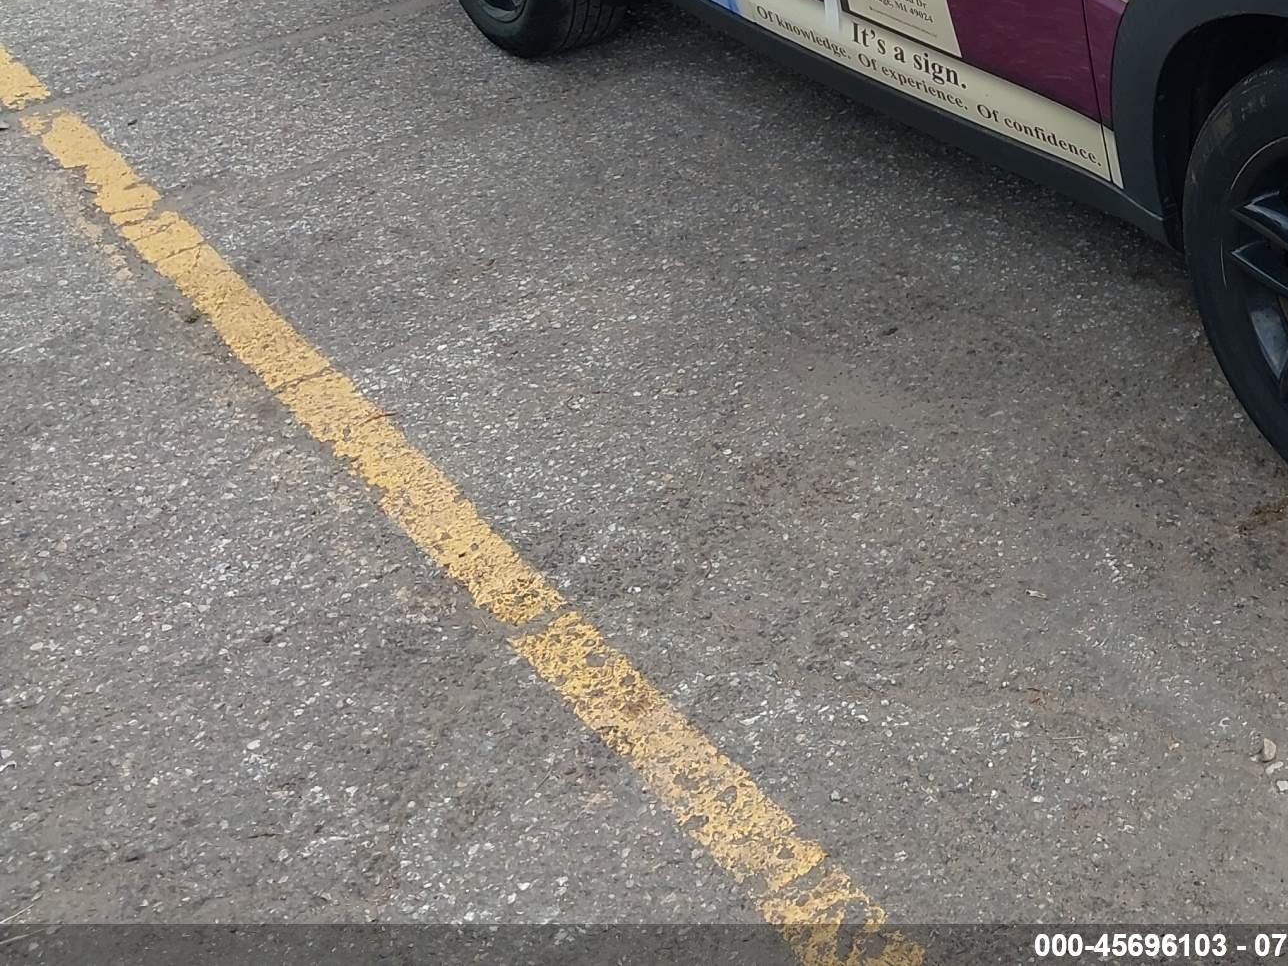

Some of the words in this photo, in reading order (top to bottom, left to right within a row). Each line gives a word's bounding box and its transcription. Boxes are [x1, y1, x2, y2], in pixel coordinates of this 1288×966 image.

[756, 4, 774, 22] Of
[775, 13, 852, 60] knowledge.
[857, 52, 879, 72] Of
[881, 65, 969, 111] experience.
[976, 103, 1001, 123] Of
[1003, 117, 1102, 167] confidence.
[850, 21, 886, 55] It's
[892, 45, 906, 64] a
[912, 51, 968, 89] sign.
